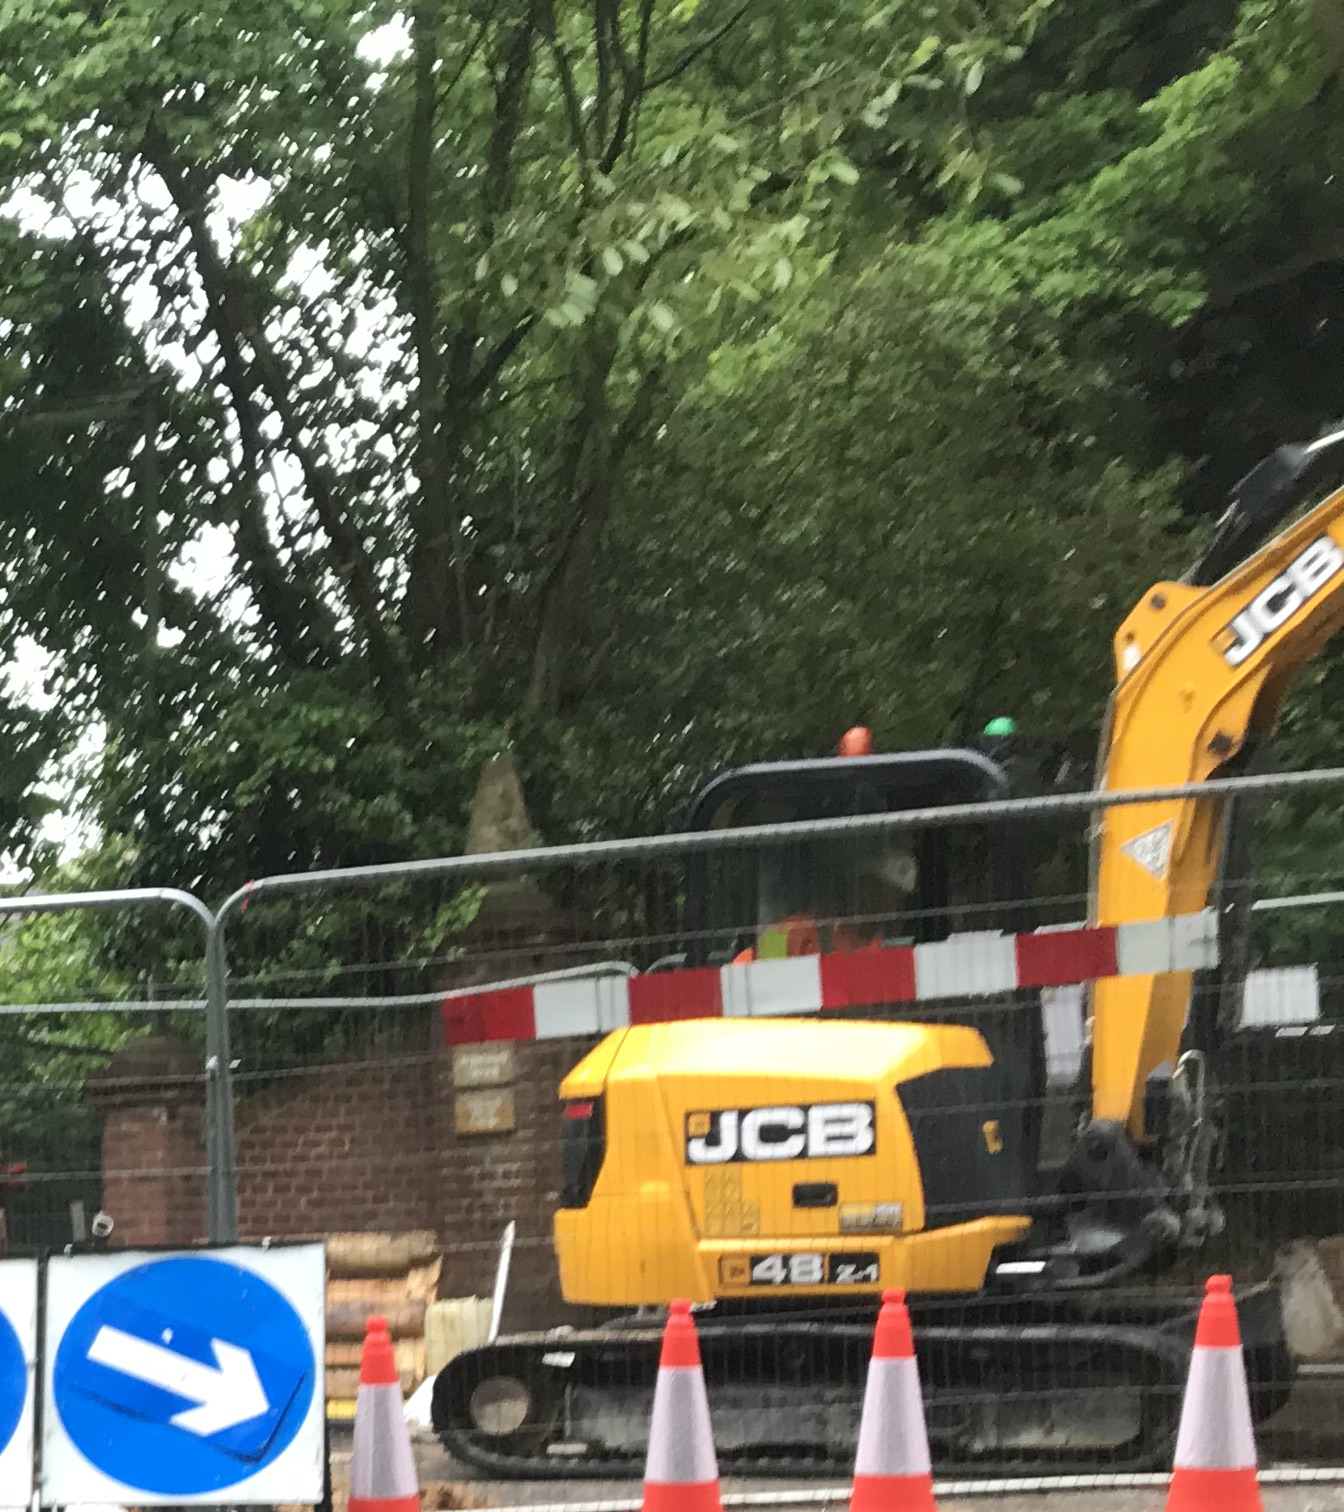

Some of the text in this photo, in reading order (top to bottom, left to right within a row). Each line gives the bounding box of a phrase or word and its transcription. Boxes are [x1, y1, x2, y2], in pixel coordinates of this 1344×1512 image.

[1223, 536, 1343, 667] JCB
[688, 1103, 874, 1163] JCB
[753, 1253, 824, 1285] 48
